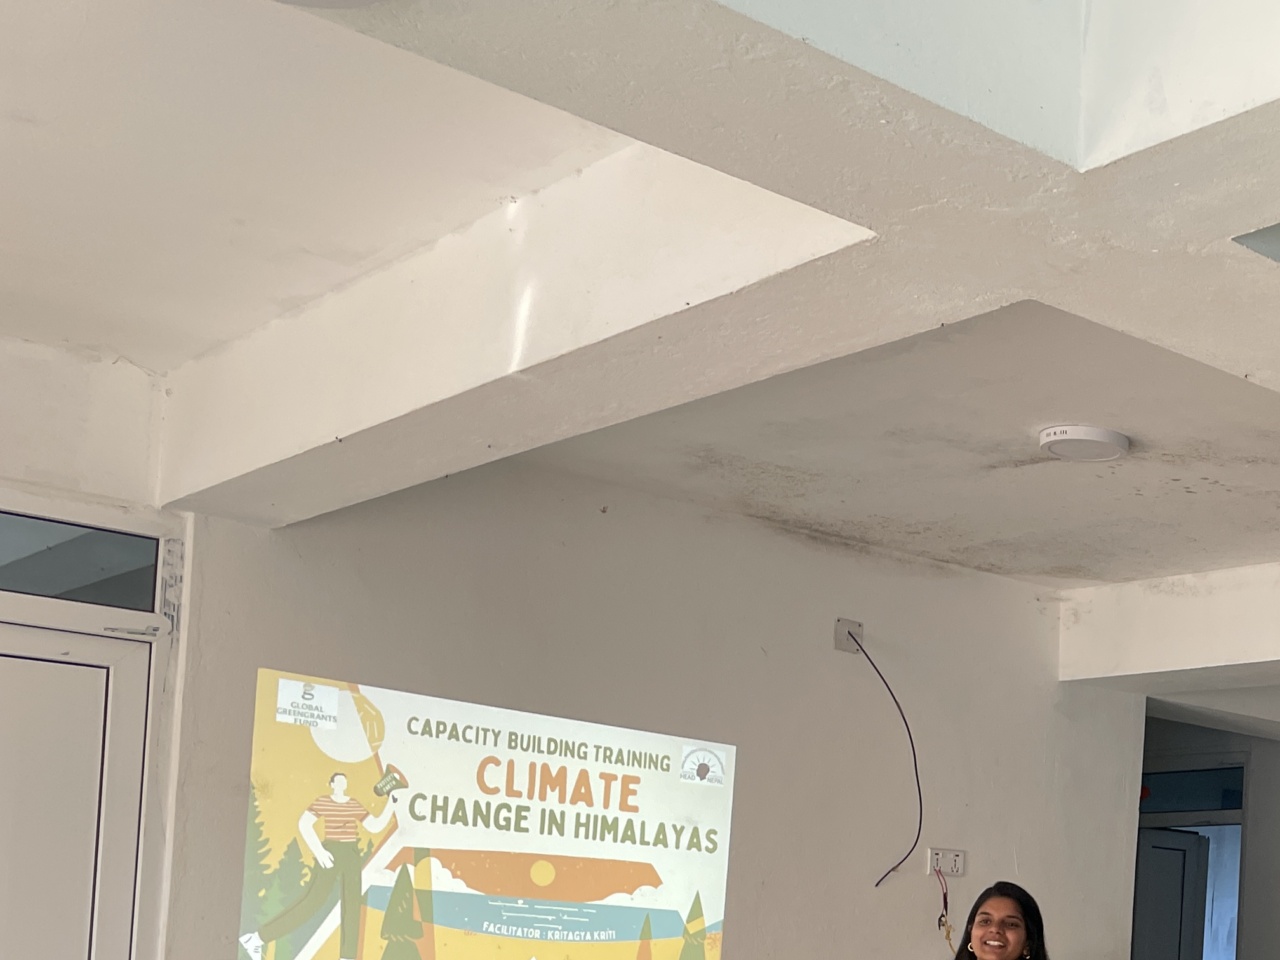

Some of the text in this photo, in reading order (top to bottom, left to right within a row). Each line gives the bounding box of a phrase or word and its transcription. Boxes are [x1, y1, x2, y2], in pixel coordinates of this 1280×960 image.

[276, 707, 338, 723] GREENGRANTS
[290, 701, 324, 713] GLOBAL
[293, 718, 319, 727] FUND
[407, 716, 671, 773] CAPACITY BUILDING TRAINING
[476, 755, 641, 813] CLIMATE
[408, 792, 718, 854] CHANGE IN HIMALAYAS
[482, 921, 541, 939] FACILITATOR
[547, 930, 592, 941] KRITAGYA
[593, 929, 616, 940] KRITI
